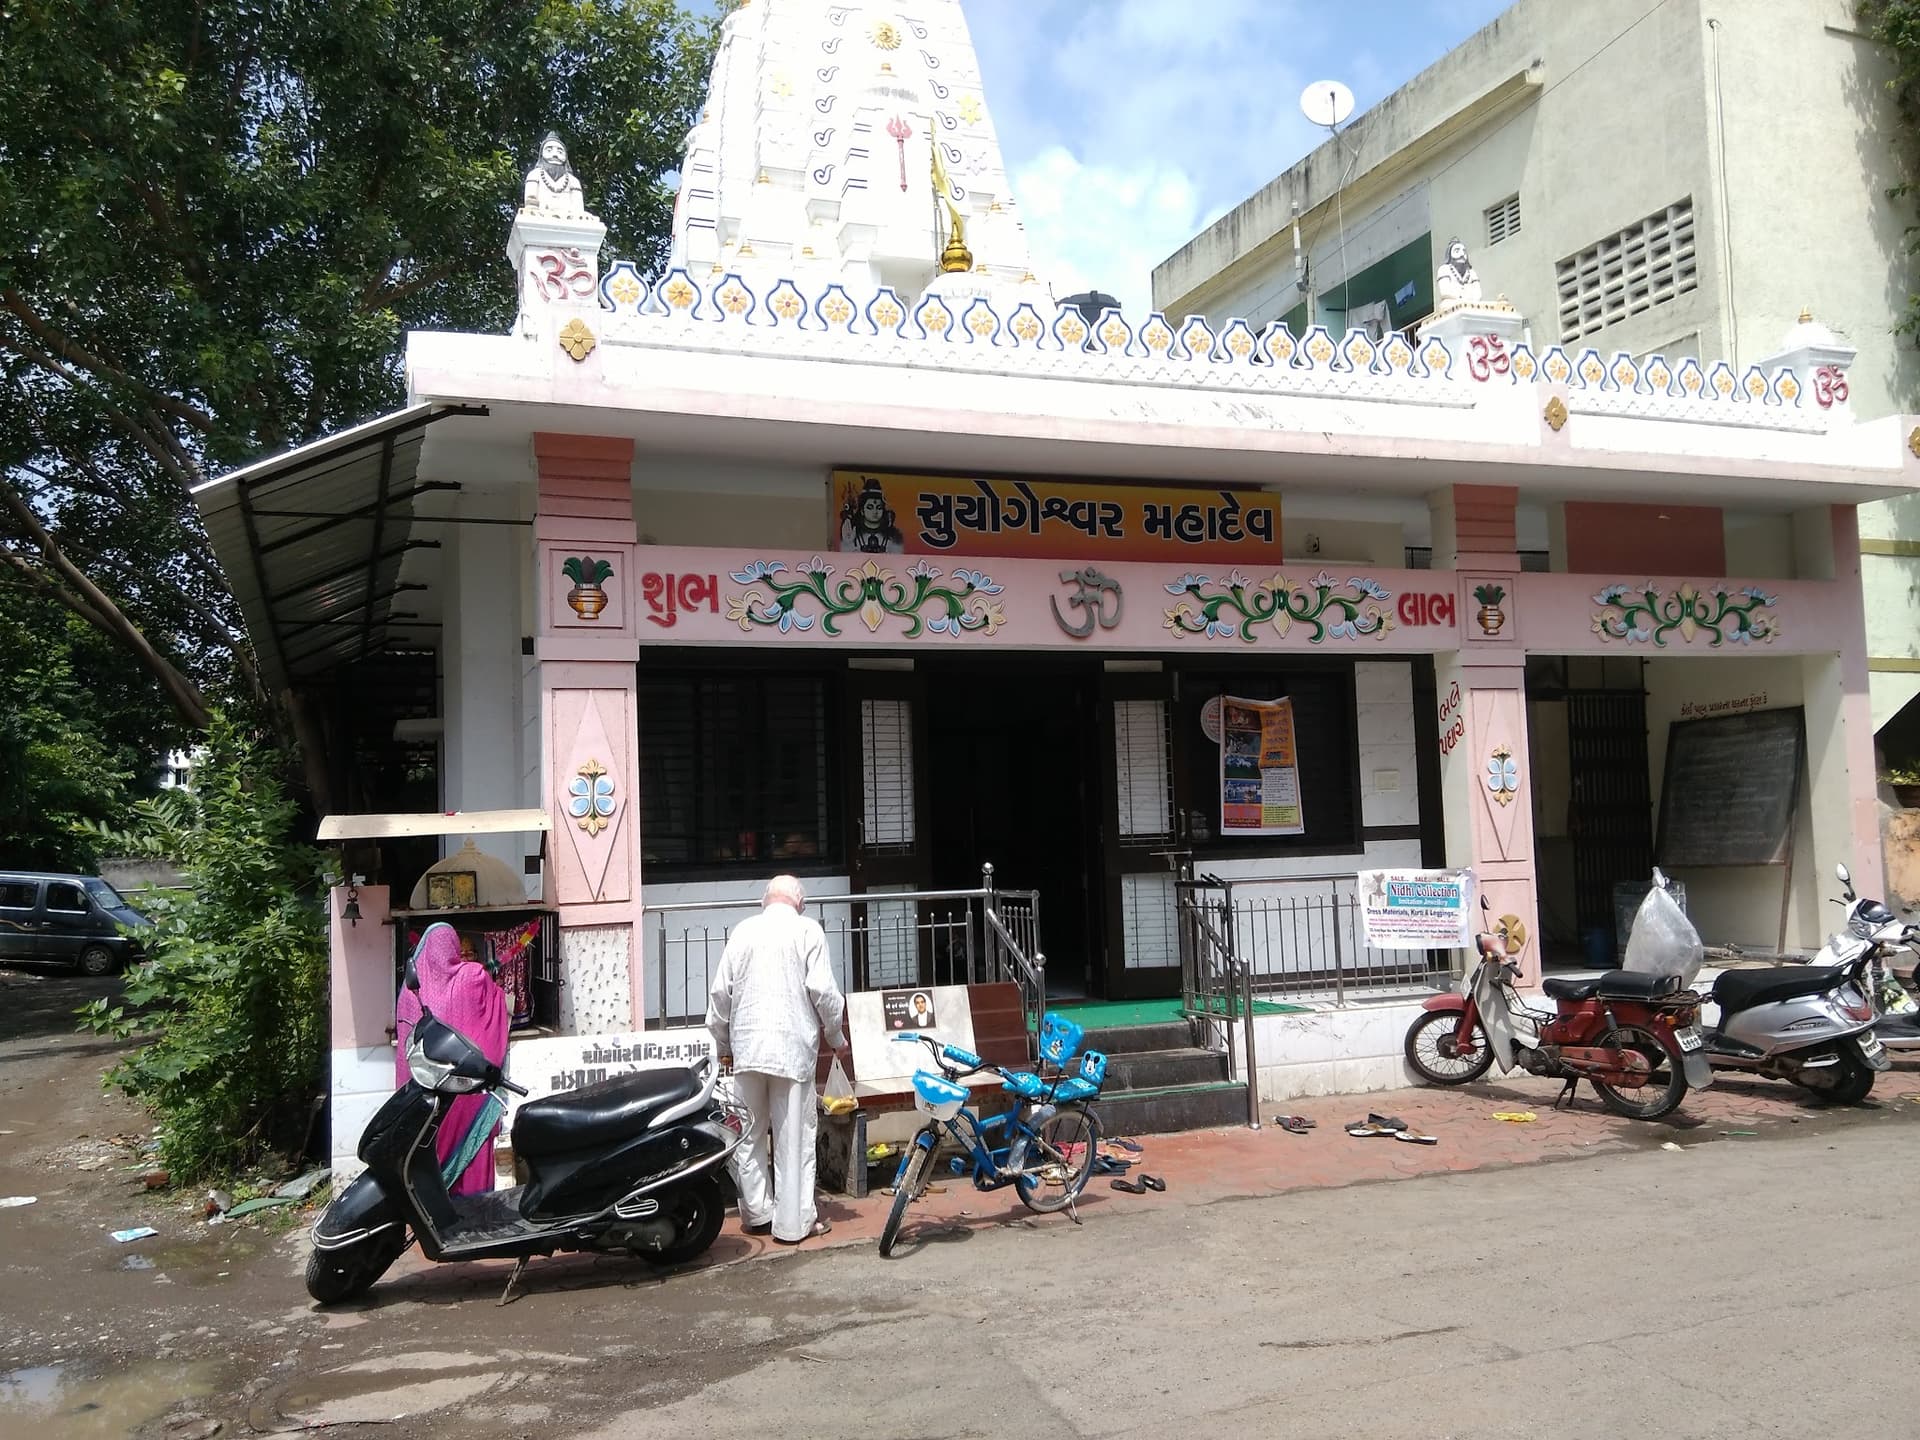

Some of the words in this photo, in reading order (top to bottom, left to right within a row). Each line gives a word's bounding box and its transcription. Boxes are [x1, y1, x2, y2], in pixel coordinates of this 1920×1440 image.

[916, 479, 1125, 549] સુયોગેશ્વર
[1143, 491, 1274, 544] મહાદેવ
[641, 571, 720, 628] શુભ
[1398, 592, 1456, 628] લાભ
[1390, 884, 1415, 897] Nidhi
[1416, 885, 1458, 898] Collection
